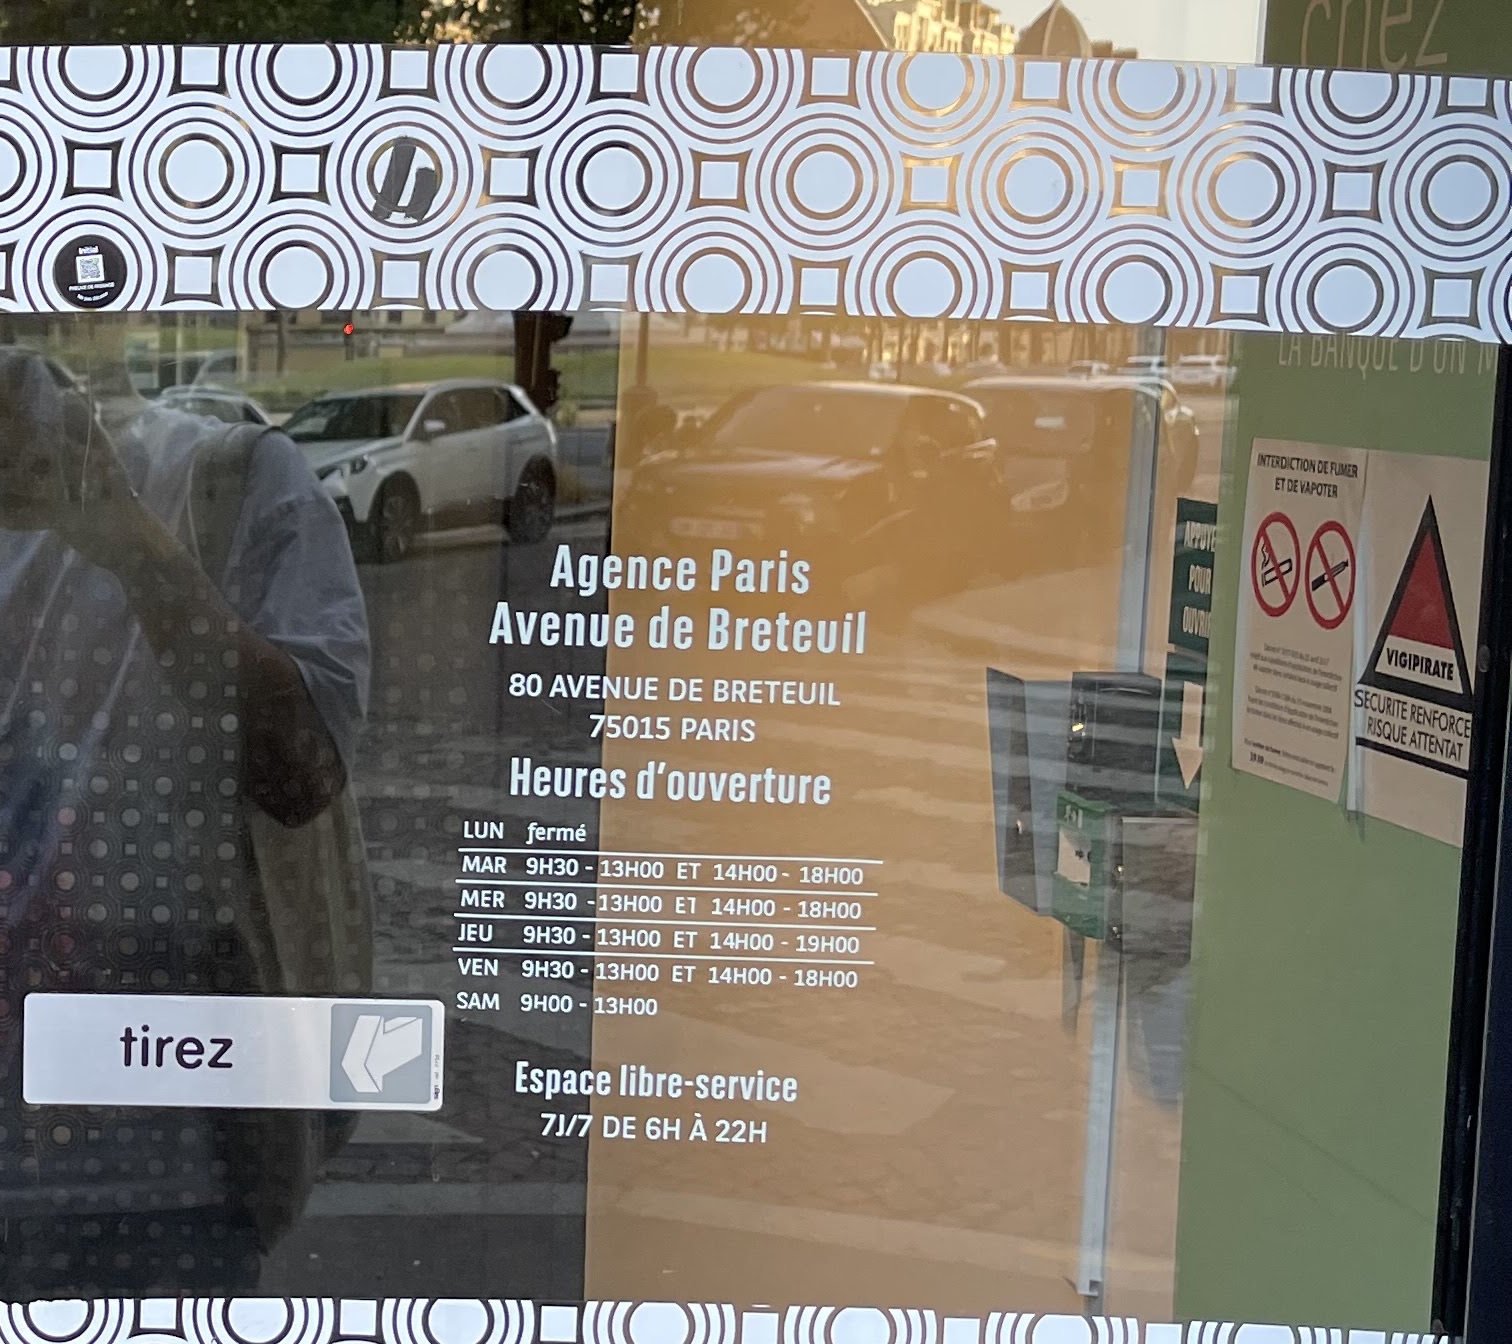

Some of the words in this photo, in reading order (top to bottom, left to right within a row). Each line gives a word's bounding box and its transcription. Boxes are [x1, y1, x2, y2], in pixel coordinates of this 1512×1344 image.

[1257, 452, 1316, 474] INTERDICTION
[1317, 459, 1329, 475] DE
[1330, 461, 1358, 479] FUMER
[1274, 477, 1286, 492] ET
[1287, 478, 1299, 493] DE
[1299, 480, 1338, 498] VAPOTER
[549, 544, 697, 597] Agence
[711, 549, 811, 595] Paris
[489, 601, 635, 649] Avenue
[648, 605, 693, 651] de
[708, 607, 866, 655] Breteuil
[1386, 647, 1454, 681] VIGIPIRATE
[508, 673, 542, 698] 80
[549, 674, 659, 702] AVENUE
[668, 678, 703, 702] DE
[713, 679, 841, 707] BRETEUIL
[1354, 689, 1408, 721] SECURITE
[588, 714, 671, 741] 75015
[681, 716, 756, 743] PARIS
[1368, 716, 1408, 746] RISQUE
[1409, 730, 1464, 762] ATTENTAT
[509, 757, 626, 799] Heures
[636, 760, 831, 806] d'ouverture
[463, 820, 504, 840] LUN
[525, 822, 587, 845] fermé
[461, 855, 507, 874] MAR
[525, 857, 579, 876] 9H30
[599, 860, 664, 879] 13H00
[676, 862, 701, 880] ET
[713, 863, 778, 883] 14H00
[799, 866, 864, 885] 18H00
[460, 889, 505, 908] MER
[524, 891, 577, 910] 9H30
[598, 894, 663, 913] 13H00
[675, 896, 697, 915] ET
[711, 897, 776, 917] 14H00
[797, 900, 862, 919] 18H00
[457, 923, 493, 942] JEU
[523, 925, 576, 944] 9H30
[596, 928, 661, 948] 13H00
[673, 930, 698, 949] ET
[709, 932, 774, 951] 14H00
[795, 934, 860, 954] 19H00
[457, 957, 499, 976] VEN
[521, 959, 575, 979] 9H30
[595, 962, 660, 982] 13H00
[671, 965, 696, 983] ET
[707, 966, 772, 985] 14H00
[793, 969, 858, 988] 18H00
[456, 991, 500, 1011] SAM
[520, 993, 573, 1013] 9H00
[593, 996, 658, 1016] 13H00
[119, 1024, 233, 1070] tirez
[515, 1060, 611, 1101] Espace
[620, 1064, 799, 1104] libre-service
[540, 1112, 593, 1140] 7J/7
[602, 1116, 637, 1141] DE
[645, 1117, 680, 1142] 6H
[688, 1112, 708, 1142] À
[714, 1118, 767, 1144] 22H
